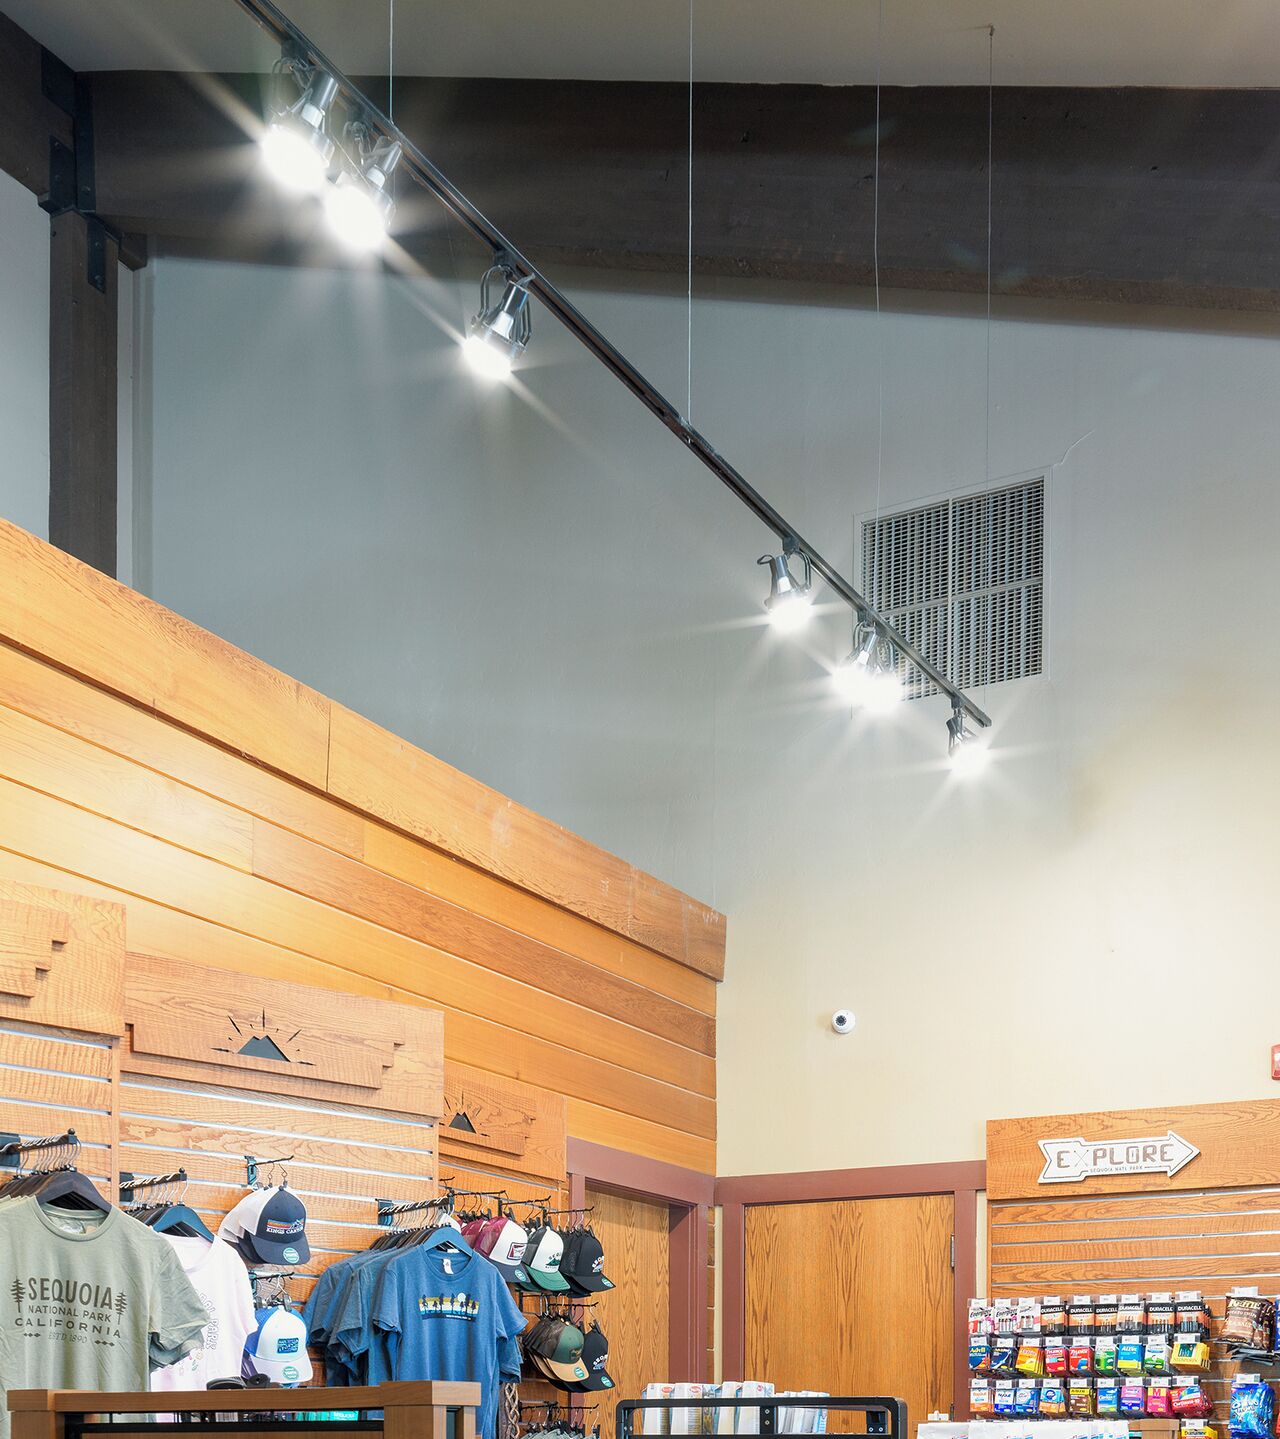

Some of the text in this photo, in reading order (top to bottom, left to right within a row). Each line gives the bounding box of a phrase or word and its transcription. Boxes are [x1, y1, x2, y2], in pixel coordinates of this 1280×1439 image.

[1057, 1144, 1174, 1168] EXPLORE
[28, 1277, 112, 1310] SEQUOIA
[29, 1305, 112, 1322] NATIONAL PARK
[1041, 1305, 1064, 1313] DURACELL
[15, 1318, 121, 1338] CALIFORNIA
